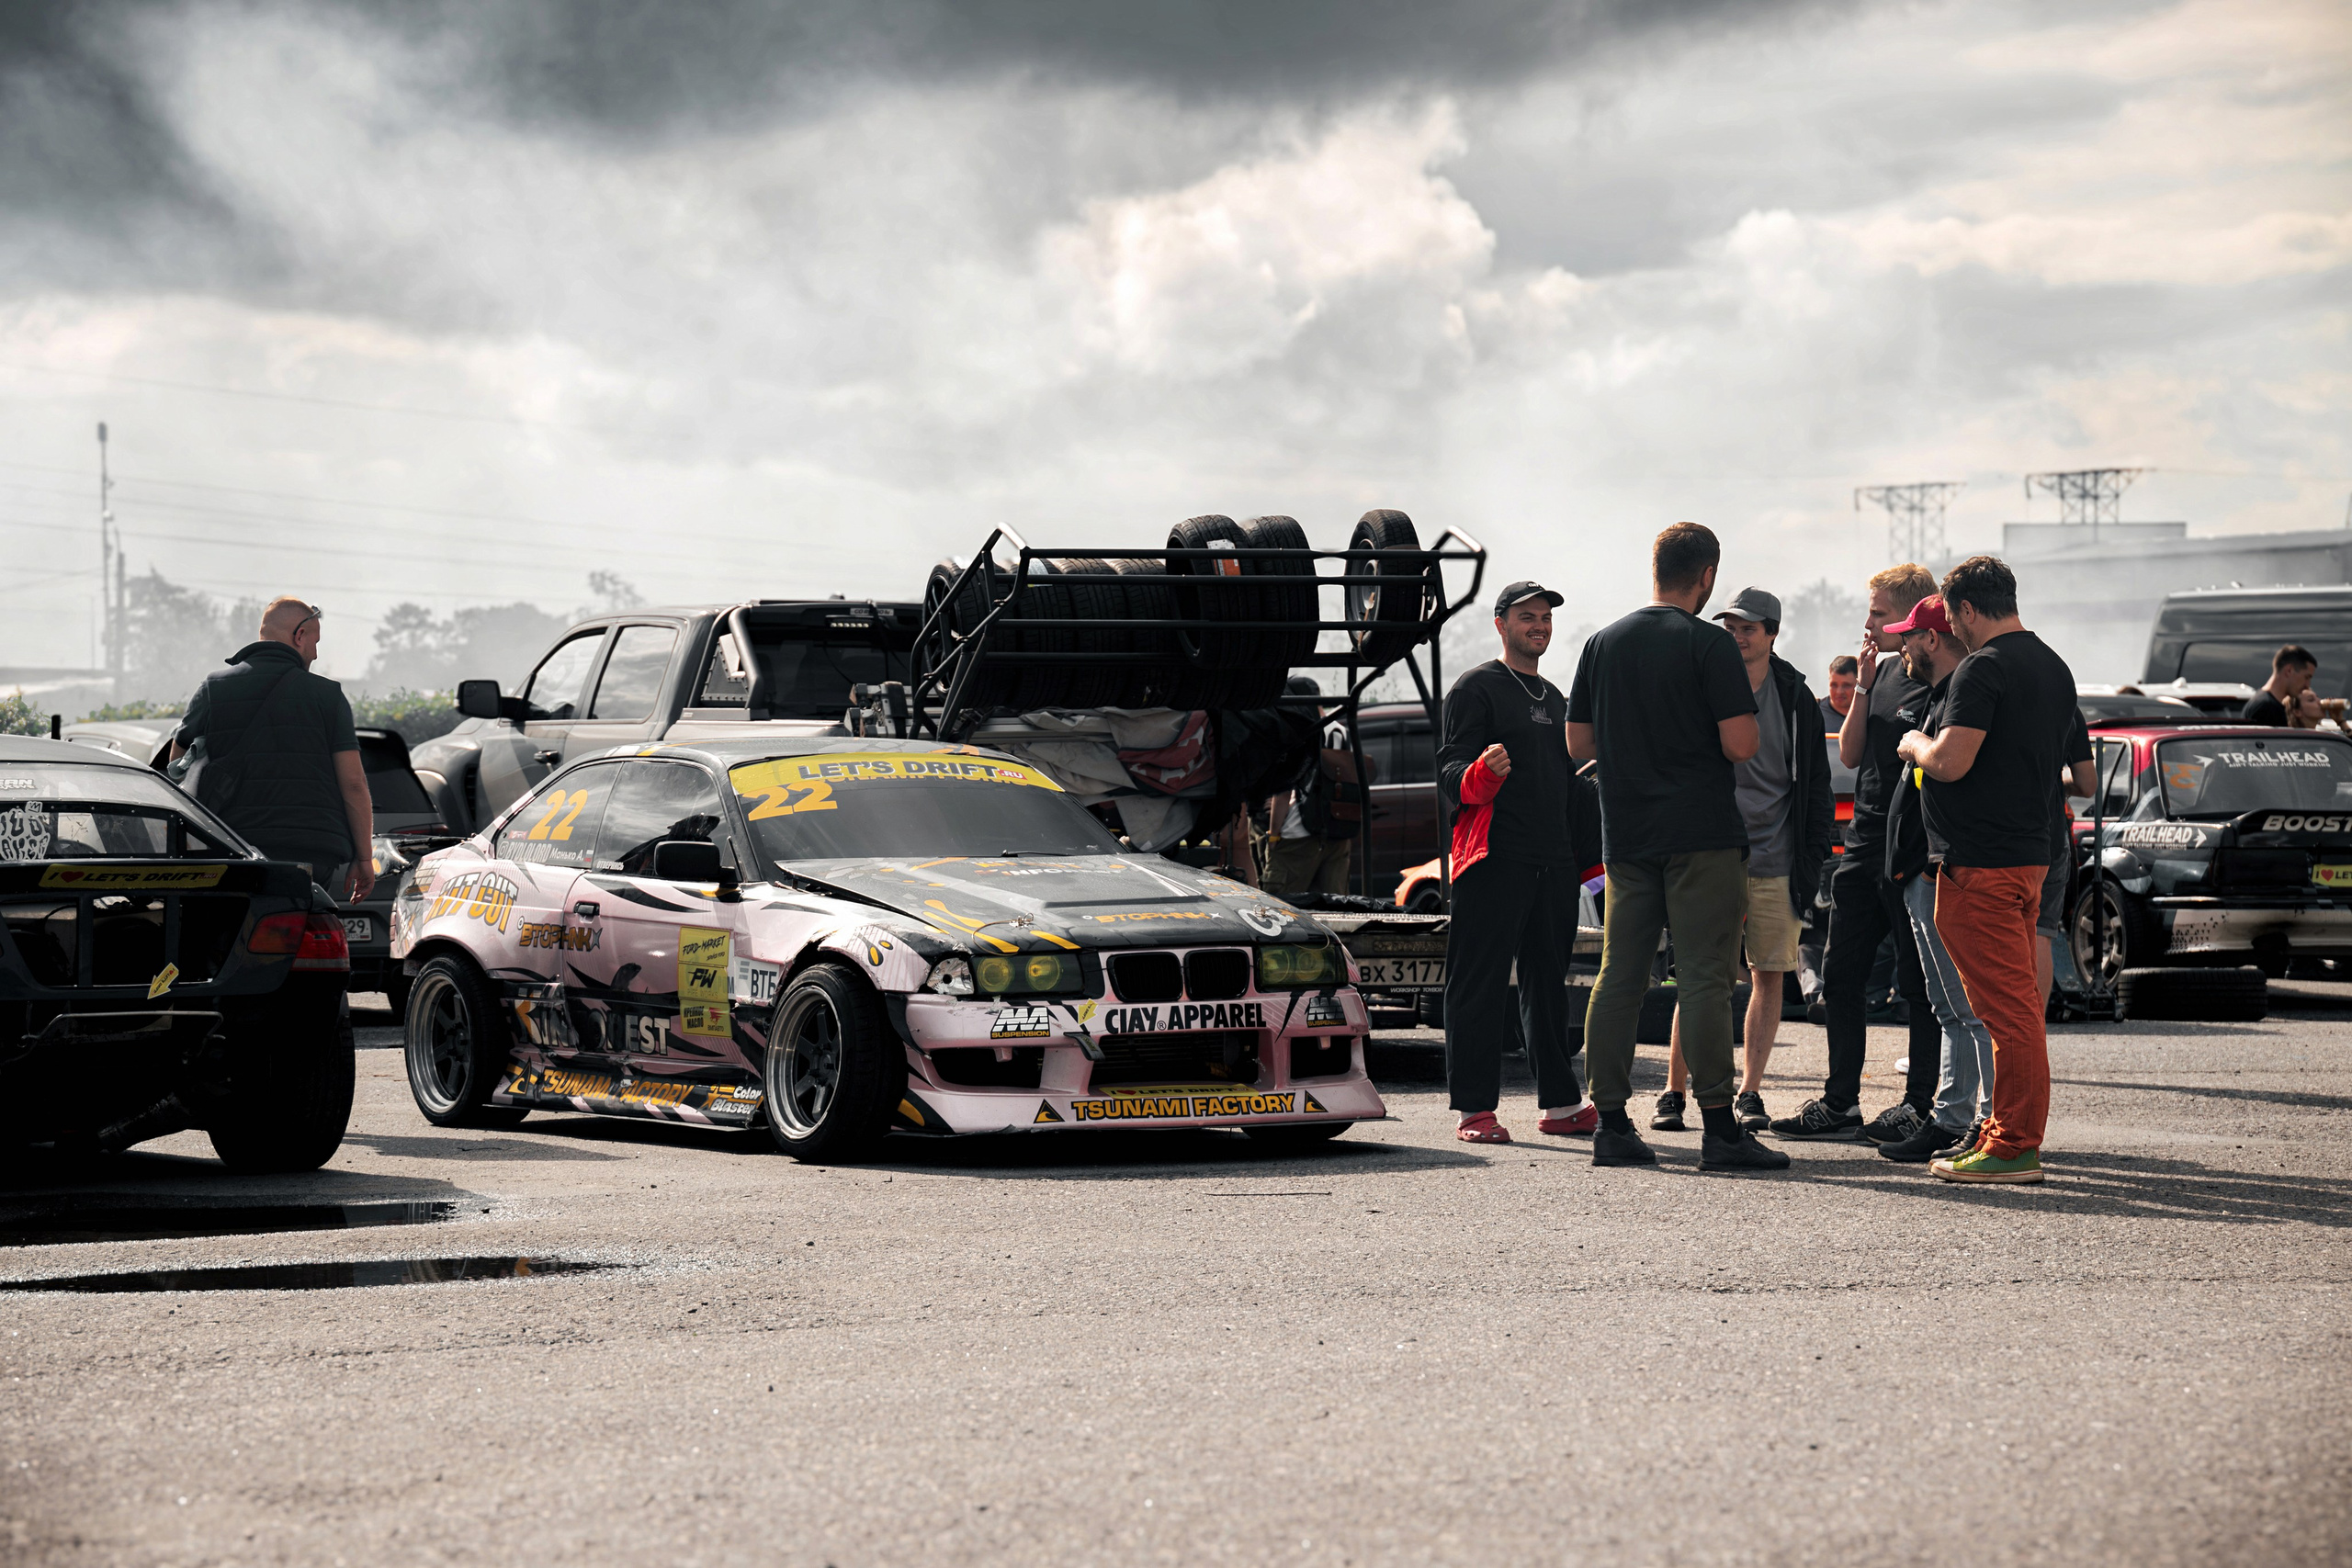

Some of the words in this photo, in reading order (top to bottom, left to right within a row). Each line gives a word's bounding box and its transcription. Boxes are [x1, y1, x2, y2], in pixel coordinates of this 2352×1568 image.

[2218, 751, 2330, 763] TRAILHEAD
[797, 760, 896, 780] LET'S
[742, 780, 838, 821] 22
[527, 789, 588, 840] 22
[2122, 826, 2193, 843] TRAILHEAD
[83, 873, 141, 882] LET'S
[346, 919, 366, 933] 29
[1361, 965, 1385, 982] BX
[1392, 960, 1446, 982] 3177
[1168, 1003, 1266, 1030] APPAREL
[733, 1084, 762, 1100] Color
[710, 1097, 757, 1115] Blaster
[1072, 1098, 1190, 1121] TSUNAMI
[1194, 1092, 1296, 1116] FACTORY
